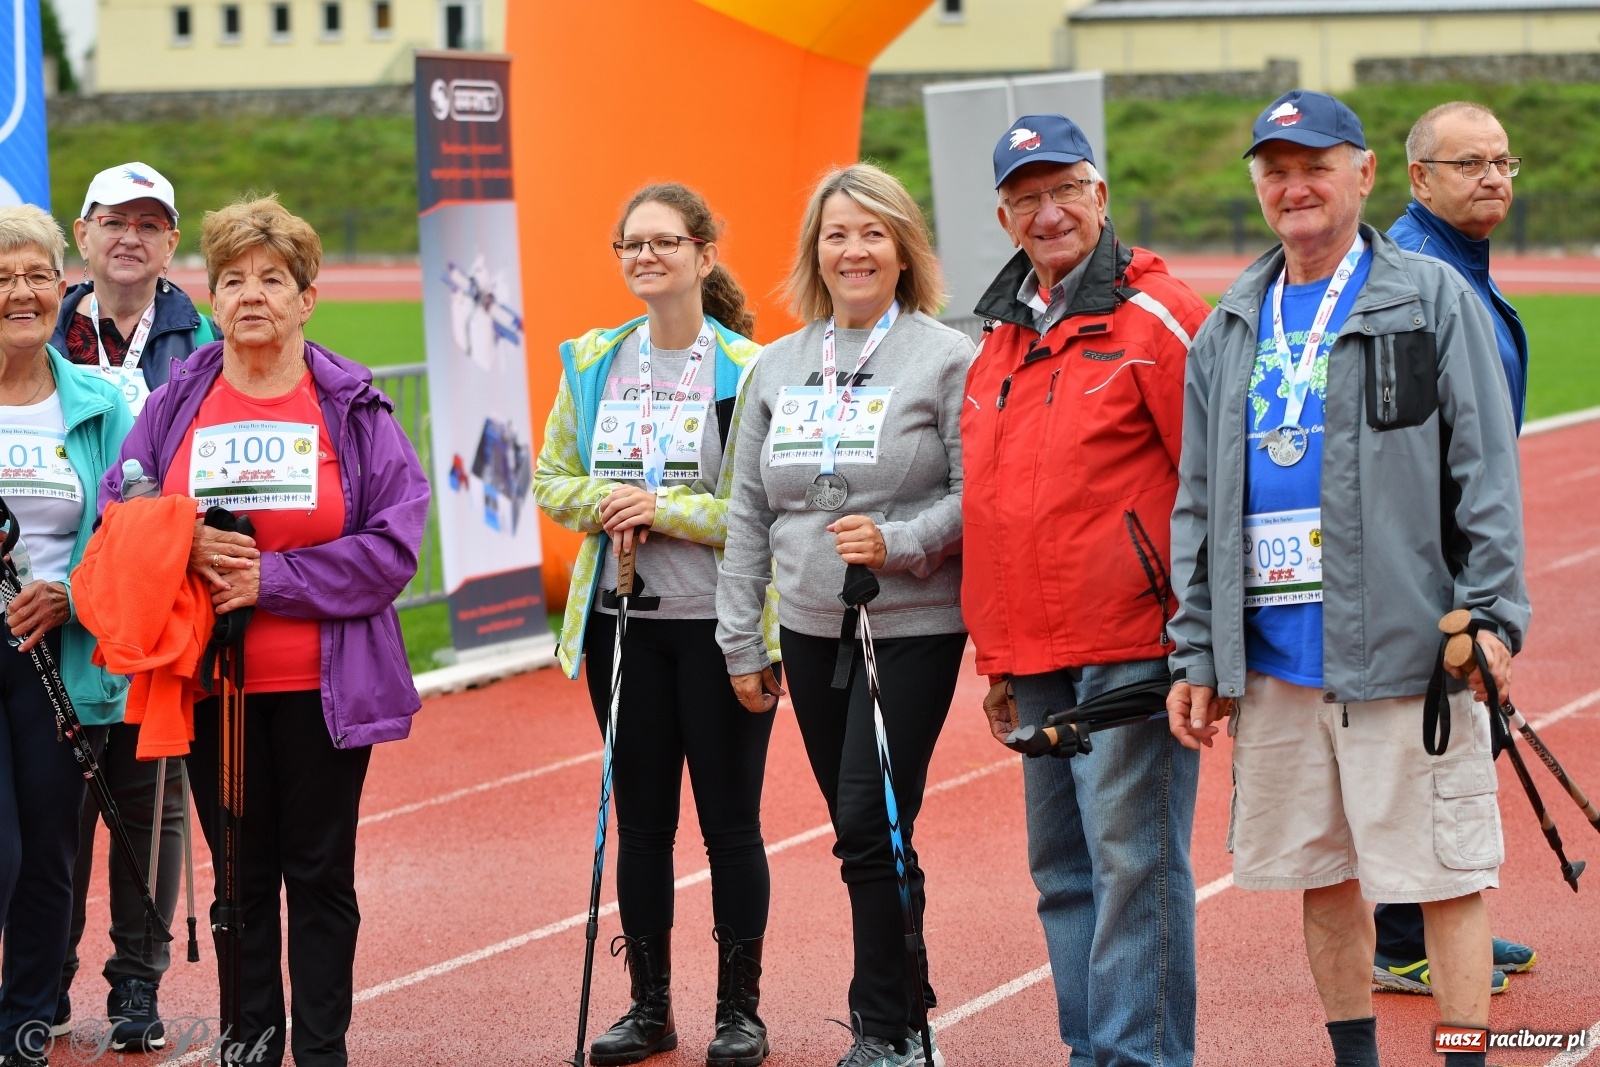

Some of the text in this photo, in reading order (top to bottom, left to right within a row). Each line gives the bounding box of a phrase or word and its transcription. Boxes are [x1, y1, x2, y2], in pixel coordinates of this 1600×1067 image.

[0, 444, 48, 468] 01
[225, 436, 284, 464] 100
[1258, 536, 1302, 568] 093
[41, 674, 66, 723] WALKING
[52, 668, 74, 716] WALKING
